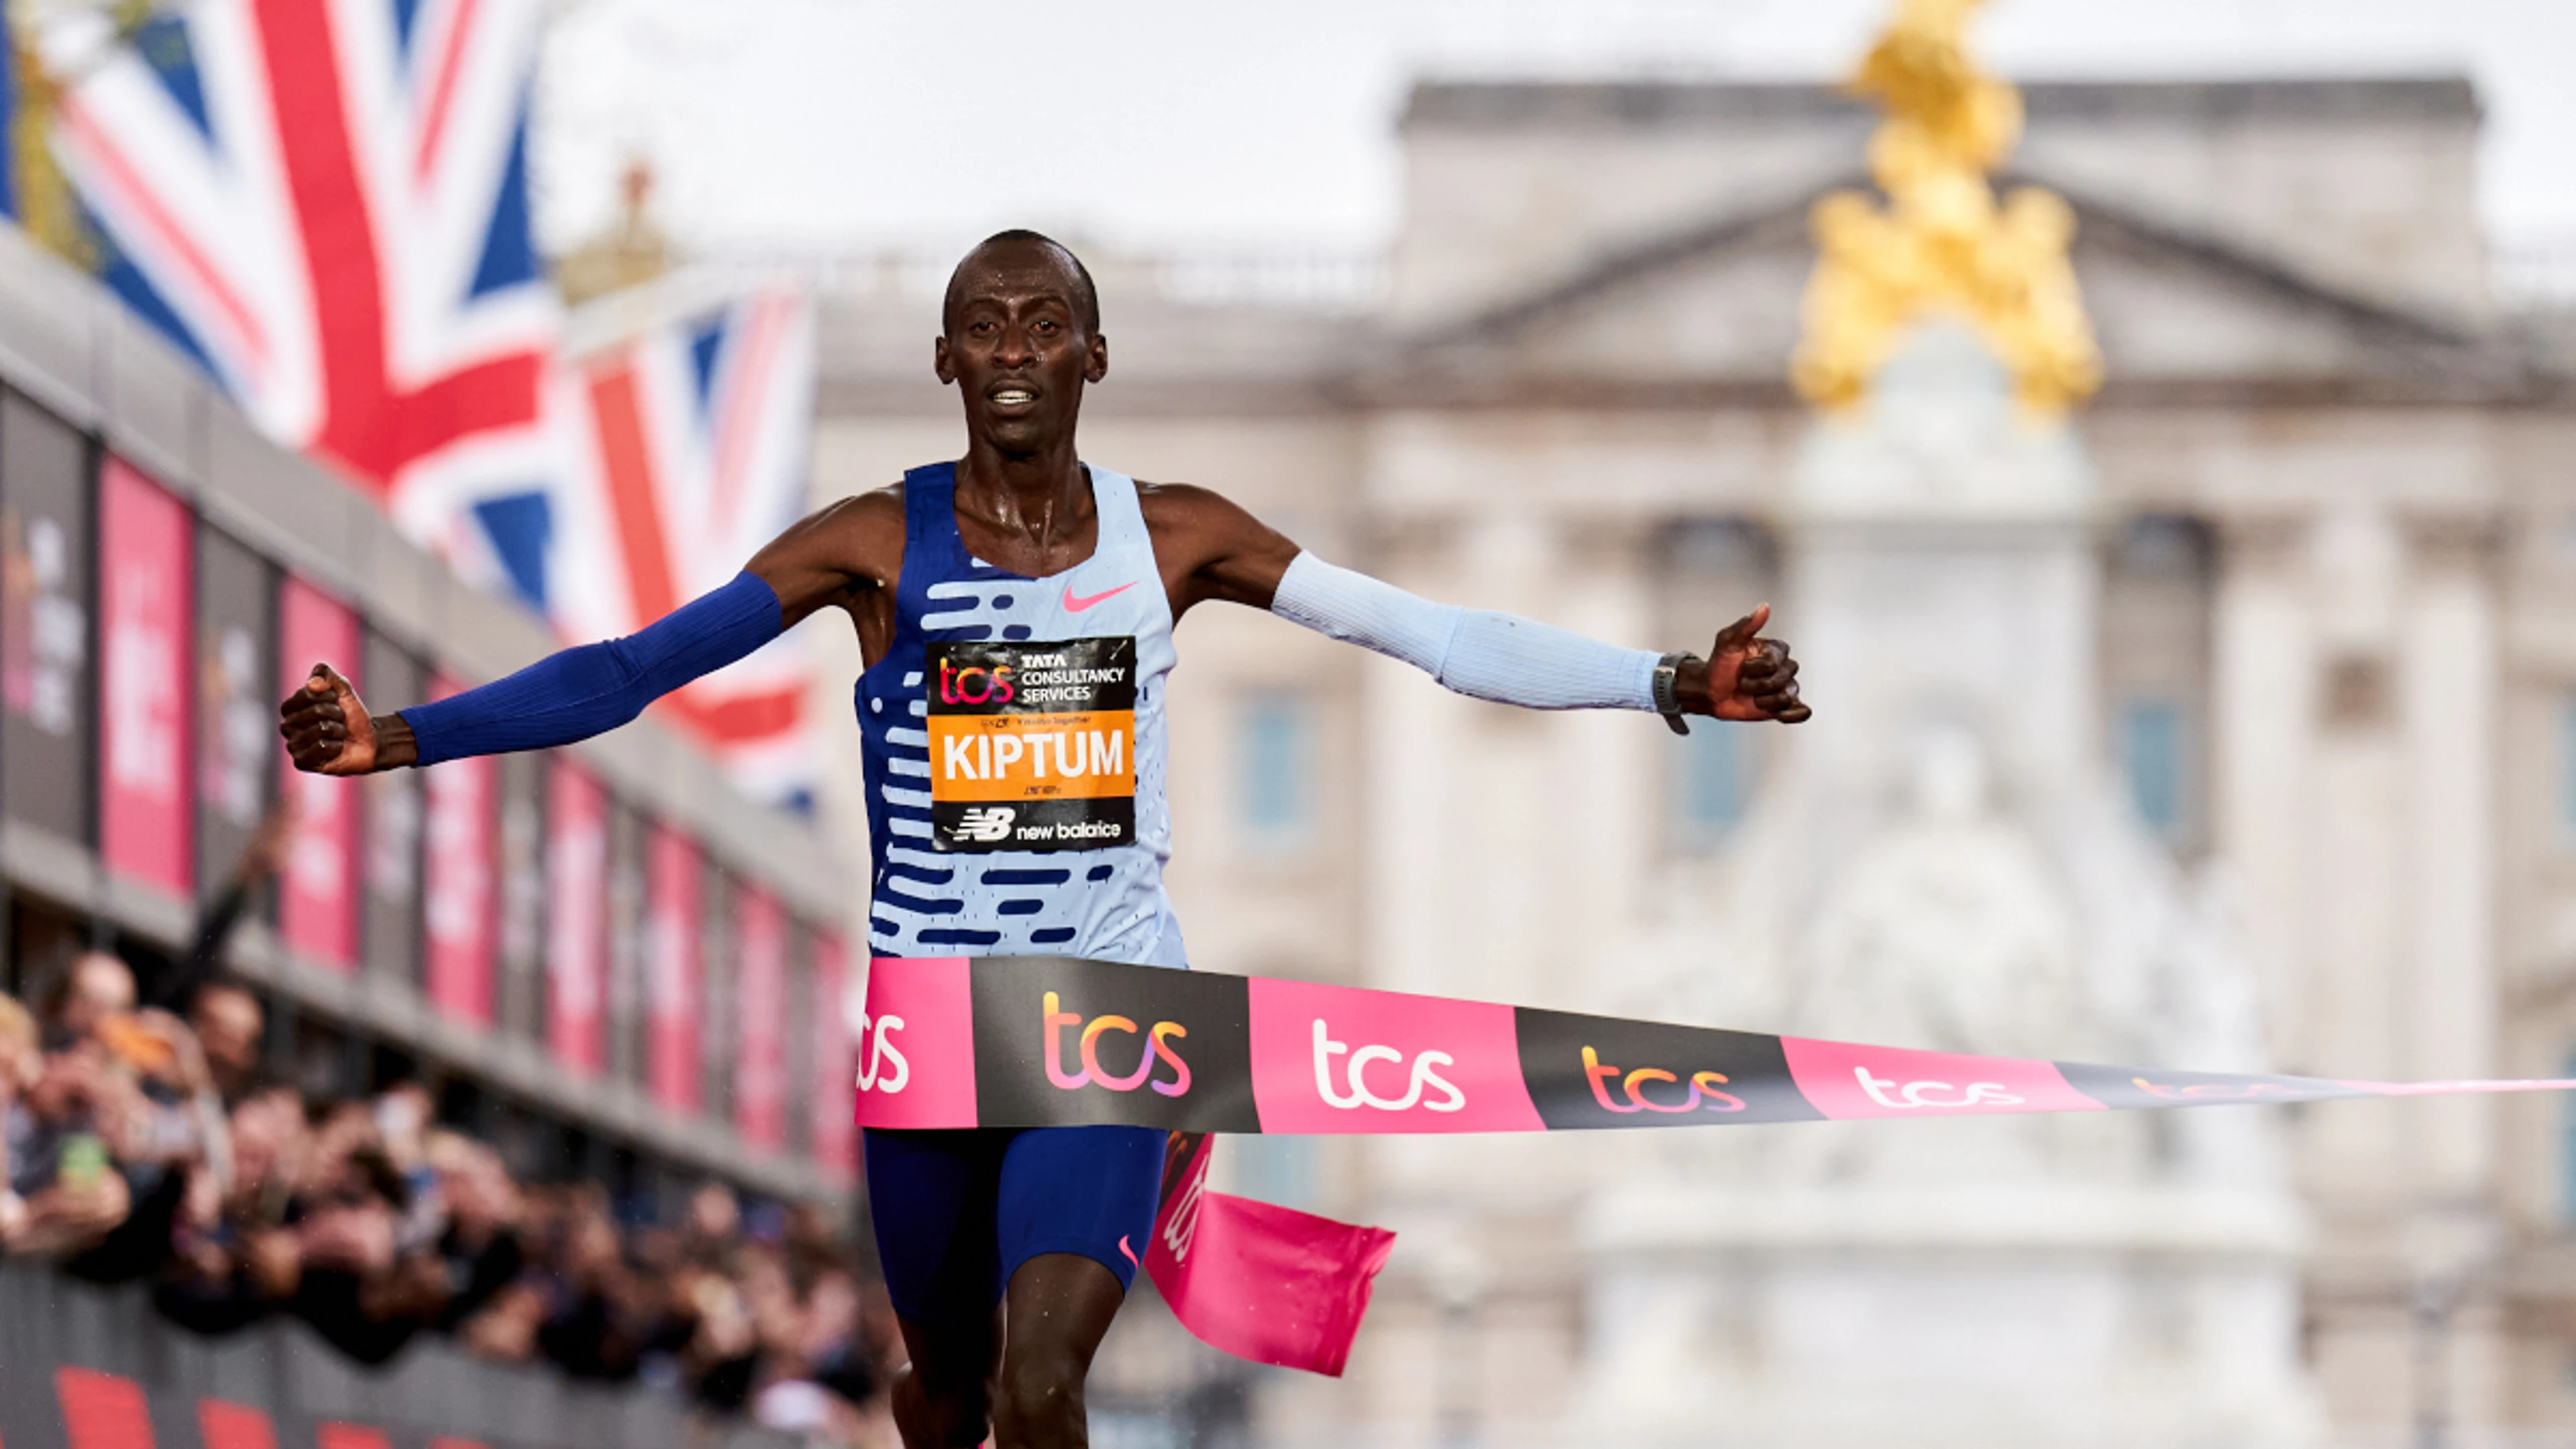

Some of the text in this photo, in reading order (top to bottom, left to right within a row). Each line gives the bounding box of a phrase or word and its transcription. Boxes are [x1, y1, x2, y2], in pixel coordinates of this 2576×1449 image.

[1021, 654, 1066, 668] TATA
[940, 657, 1014, 704] tcs
[1021, 667, 1125, 686] CONSULTANCY
[1022, 686, 1091, 702] SERVICES
[944, 730, 1123, 780] KIPTUM
[1016, 822, 1121, 840] new balance
[1043, 991, 1191, 1097] tcs
[1312, 1019, 1465, 1112] tcs
[1580, 1046, 1747, 1113] tcs
[1854, 1066, 2025, 1107] tcs
